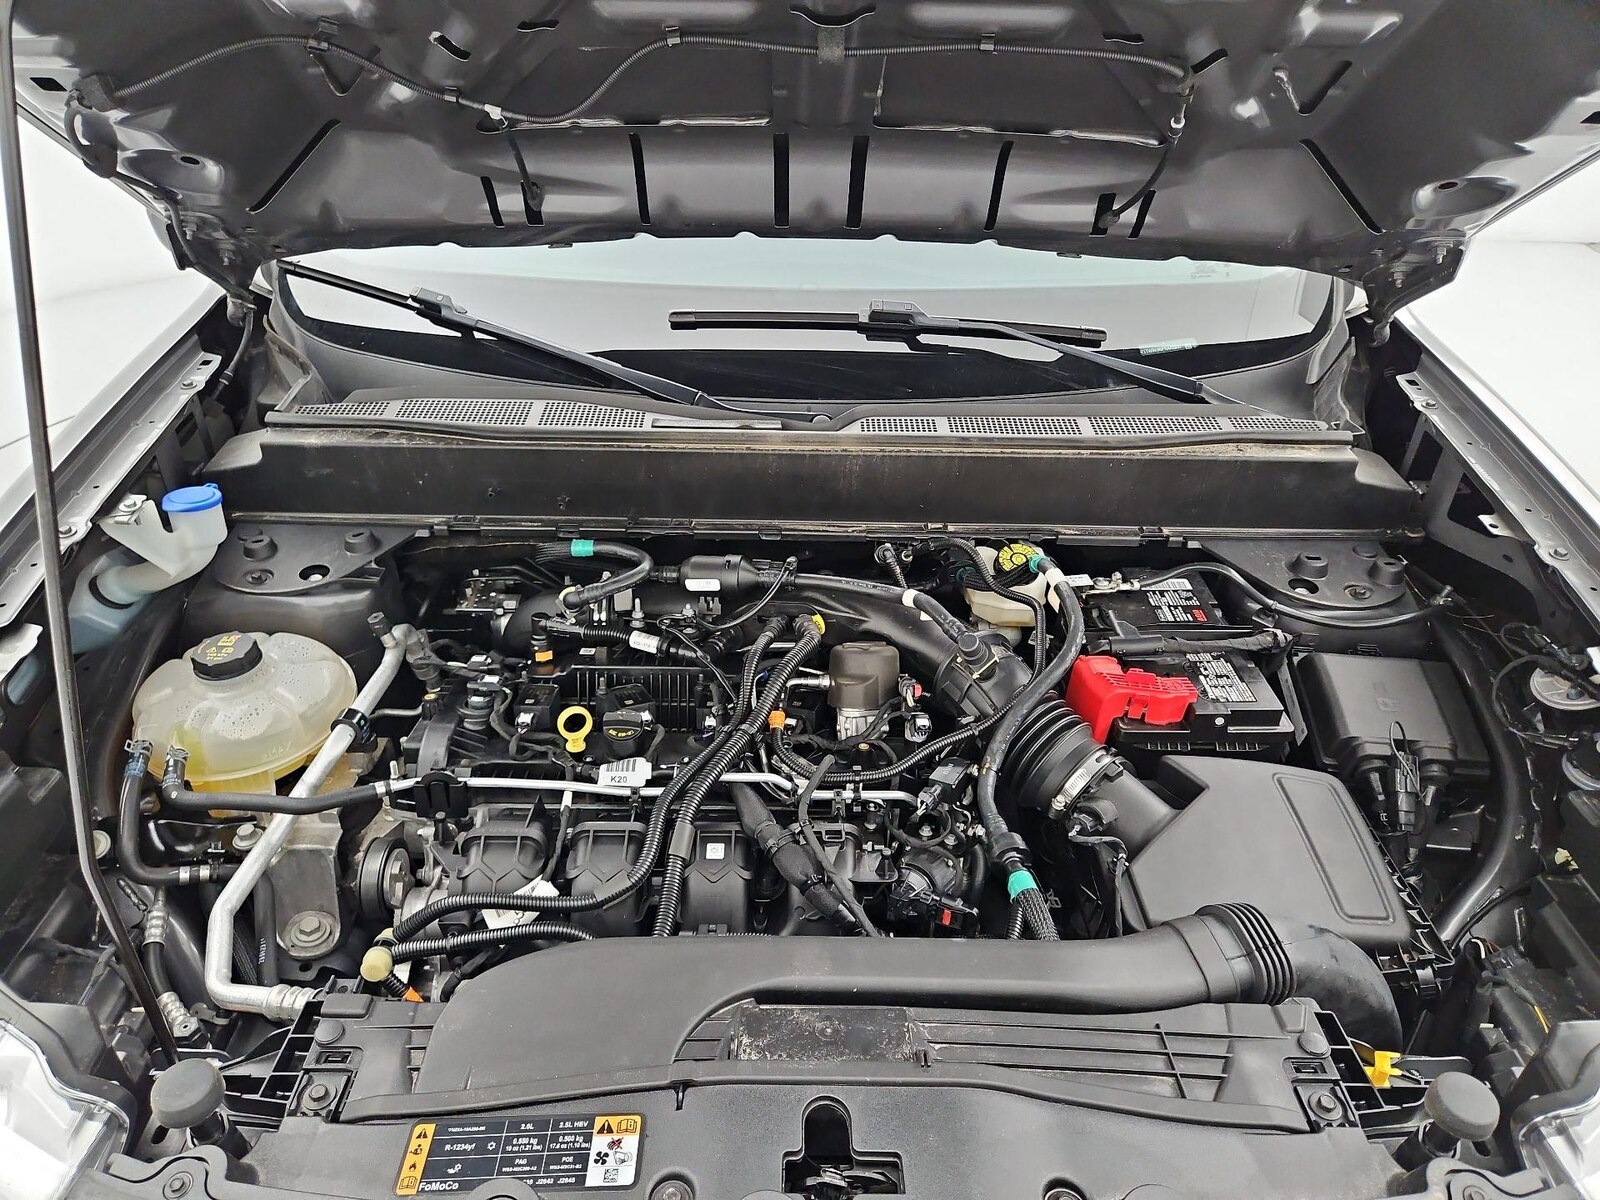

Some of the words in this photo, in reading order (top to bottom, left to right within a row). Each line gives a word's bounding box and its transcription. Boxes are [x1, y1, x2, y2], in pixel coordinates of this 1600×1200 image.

[610, 776, 628, 784] K20
[444, 1143, 476, 1151] R-1234yf
[418, 1182, 459, 1192] FoMoCo
